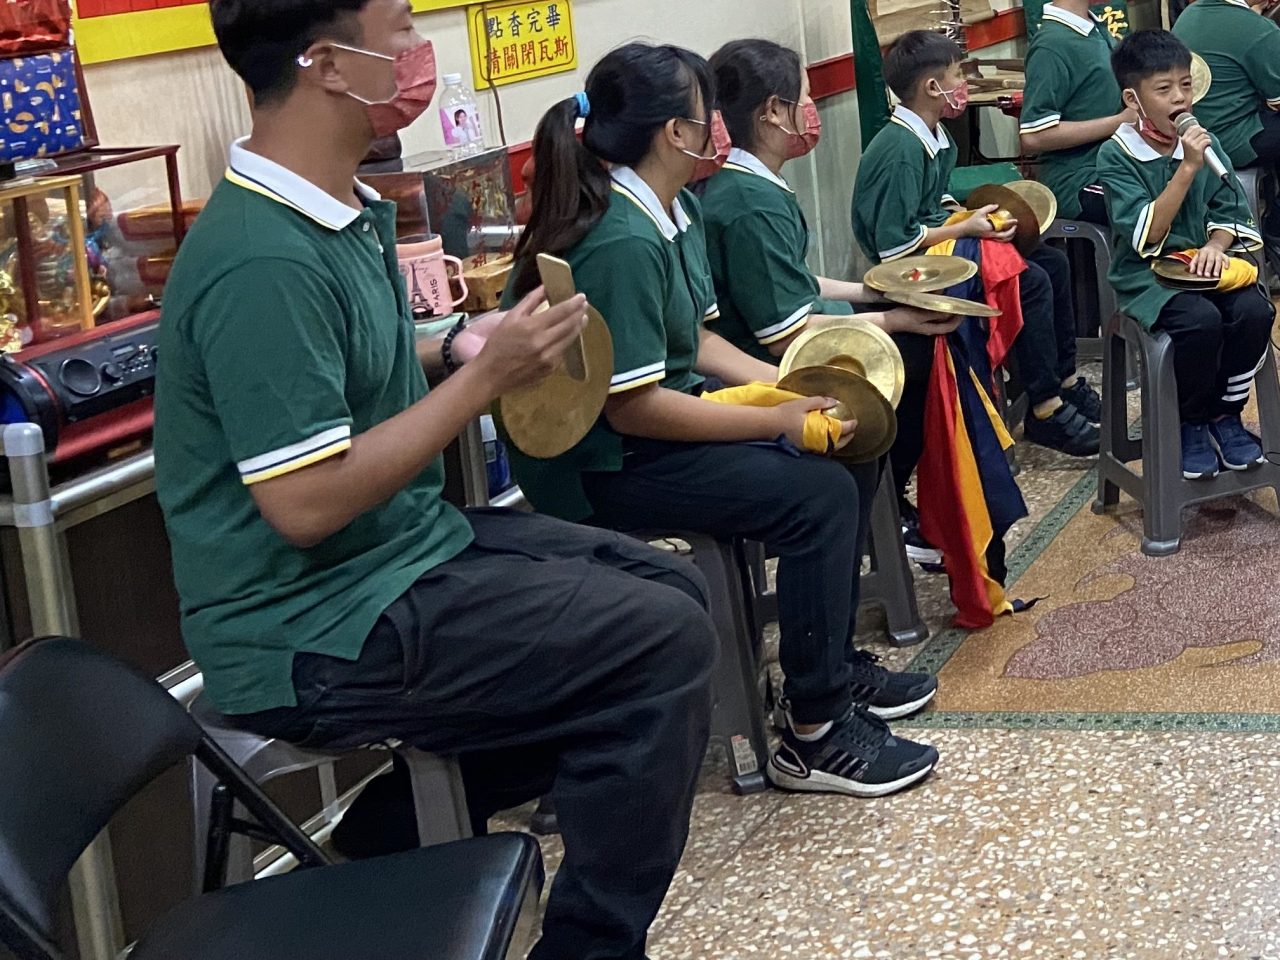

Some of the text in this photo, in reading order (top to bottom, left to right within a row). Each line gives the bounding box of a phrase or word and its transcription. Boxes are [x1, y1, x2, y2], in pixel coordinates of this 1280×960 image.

[487, 3, 561, 38] 點香完畢
[484, 36, 569, 75] 請關閉瓦斯
[430, 278, 440, 308] PARIS
